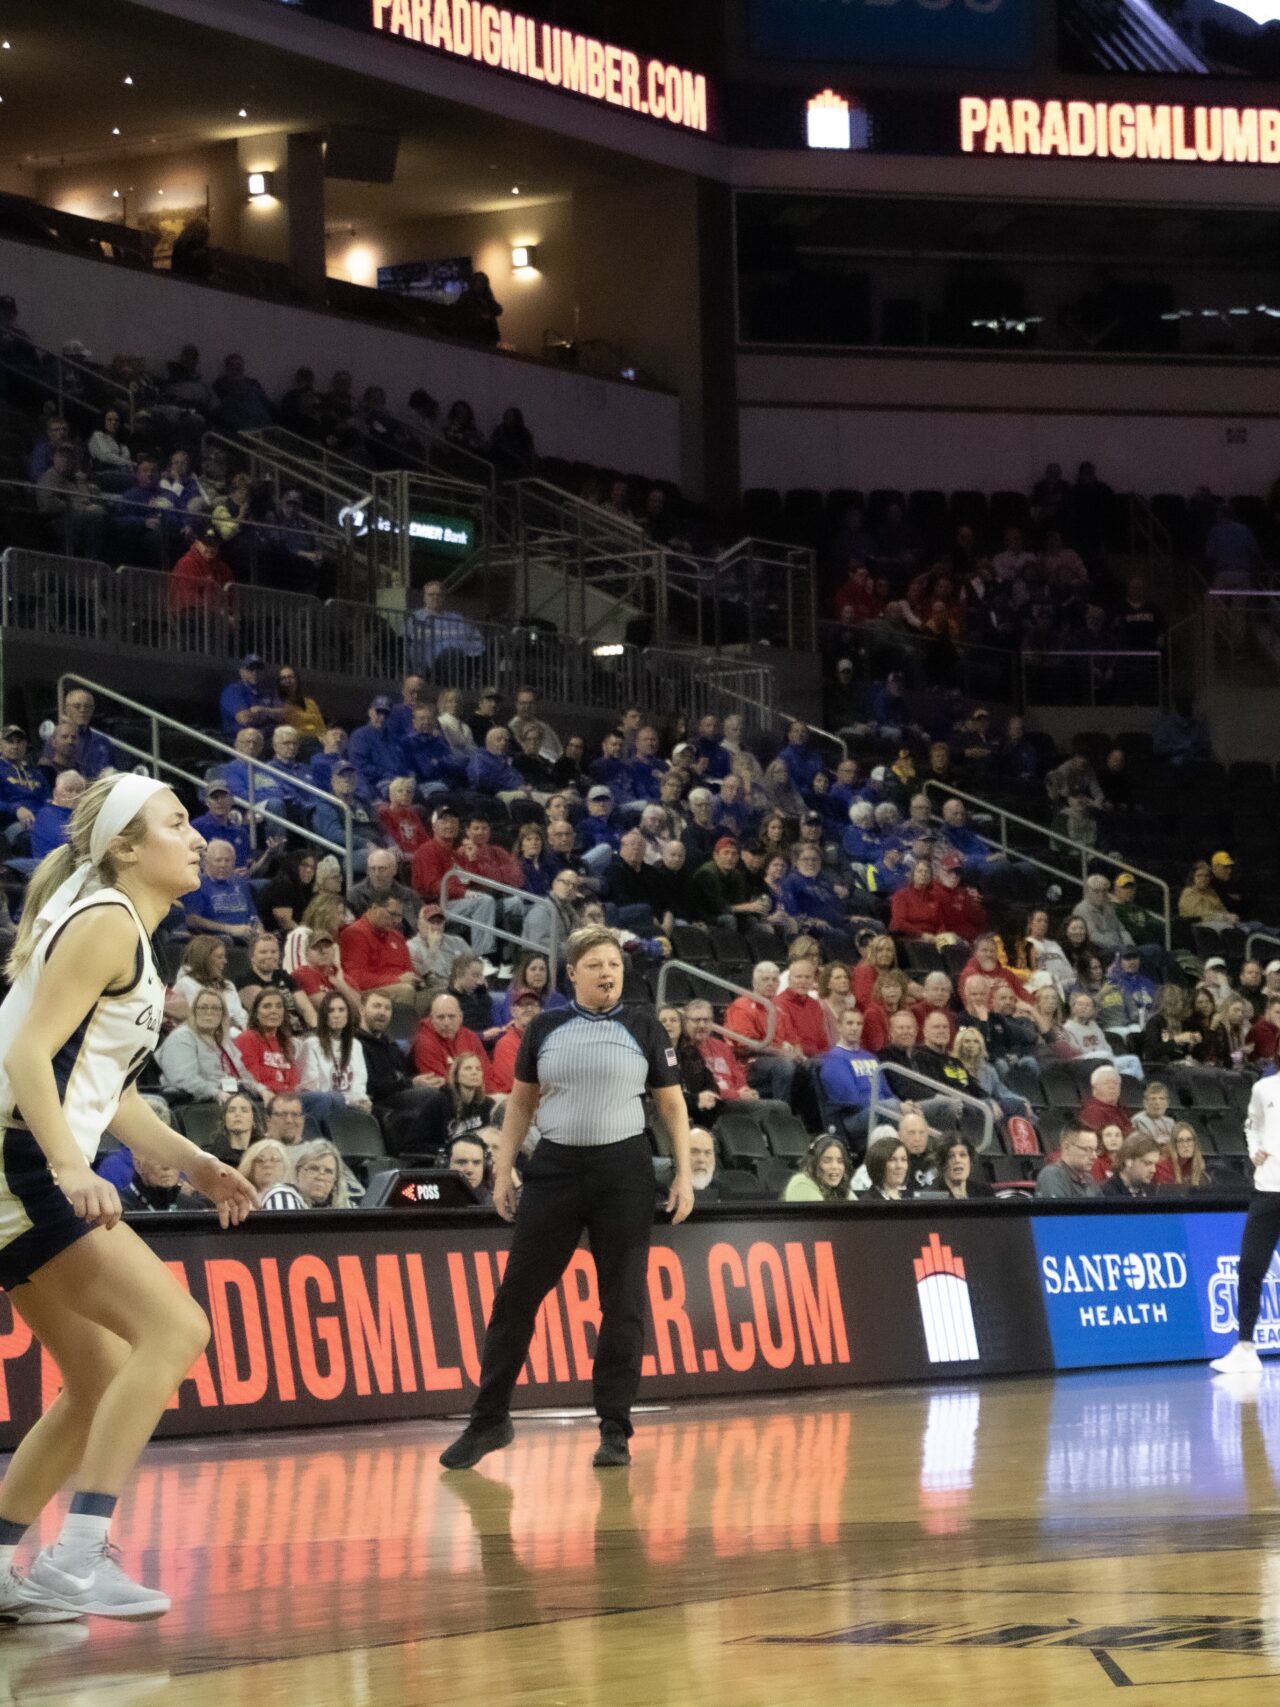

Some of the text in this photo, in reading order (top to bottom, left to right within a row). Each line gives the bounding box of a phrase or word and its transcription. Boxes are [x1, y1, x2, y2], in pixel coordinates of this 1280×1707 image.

[372, 0, 708, 132] PARADIGMLUMBER.COM
[416, 1184, 440, 1200] POSS
[1042, 1252, 1187, 1295] SANFORD
[1079, 1303, 1168, 1326] HEALTH
